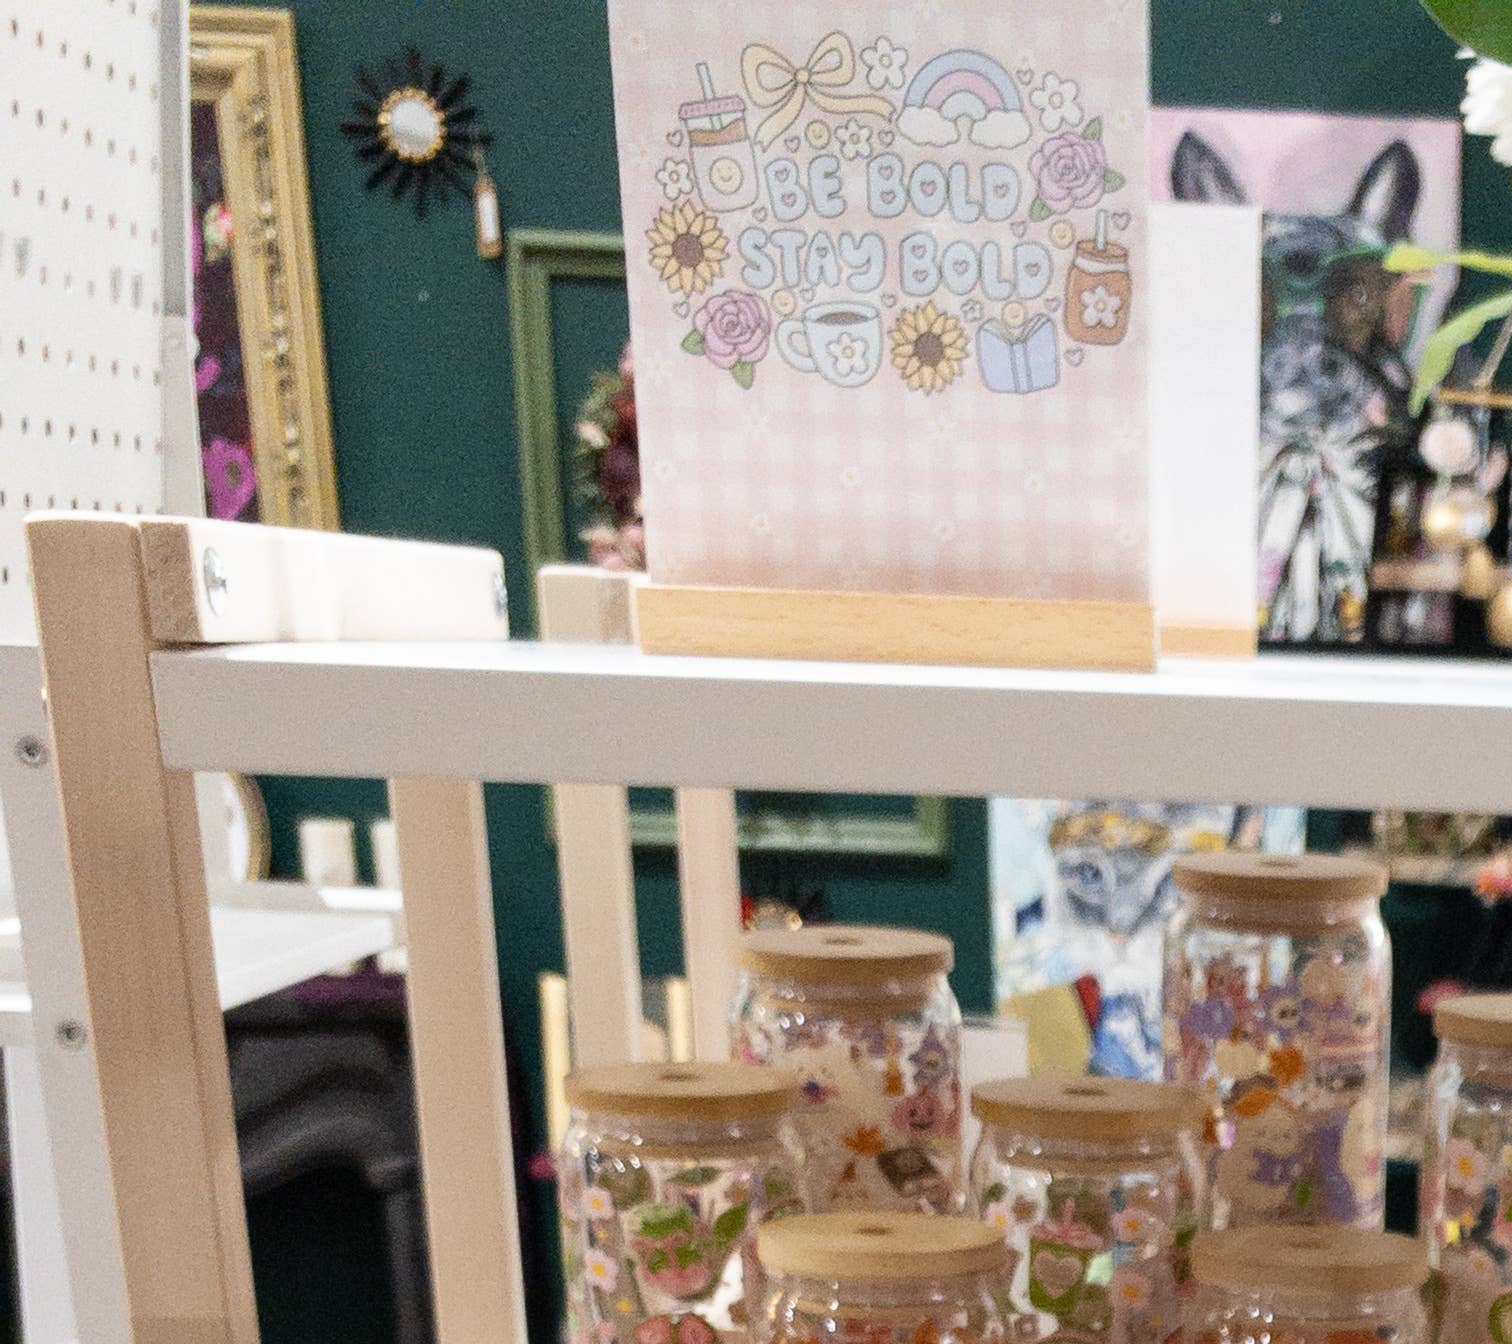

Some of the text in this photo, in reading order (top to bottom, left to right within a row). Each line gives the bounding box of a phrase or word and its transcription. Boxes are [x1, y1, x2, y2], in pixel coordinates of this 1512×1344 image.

[763, 151, 1022, 224] BE BOLD
[737, 226, 1051, 301] STAY BOLD
